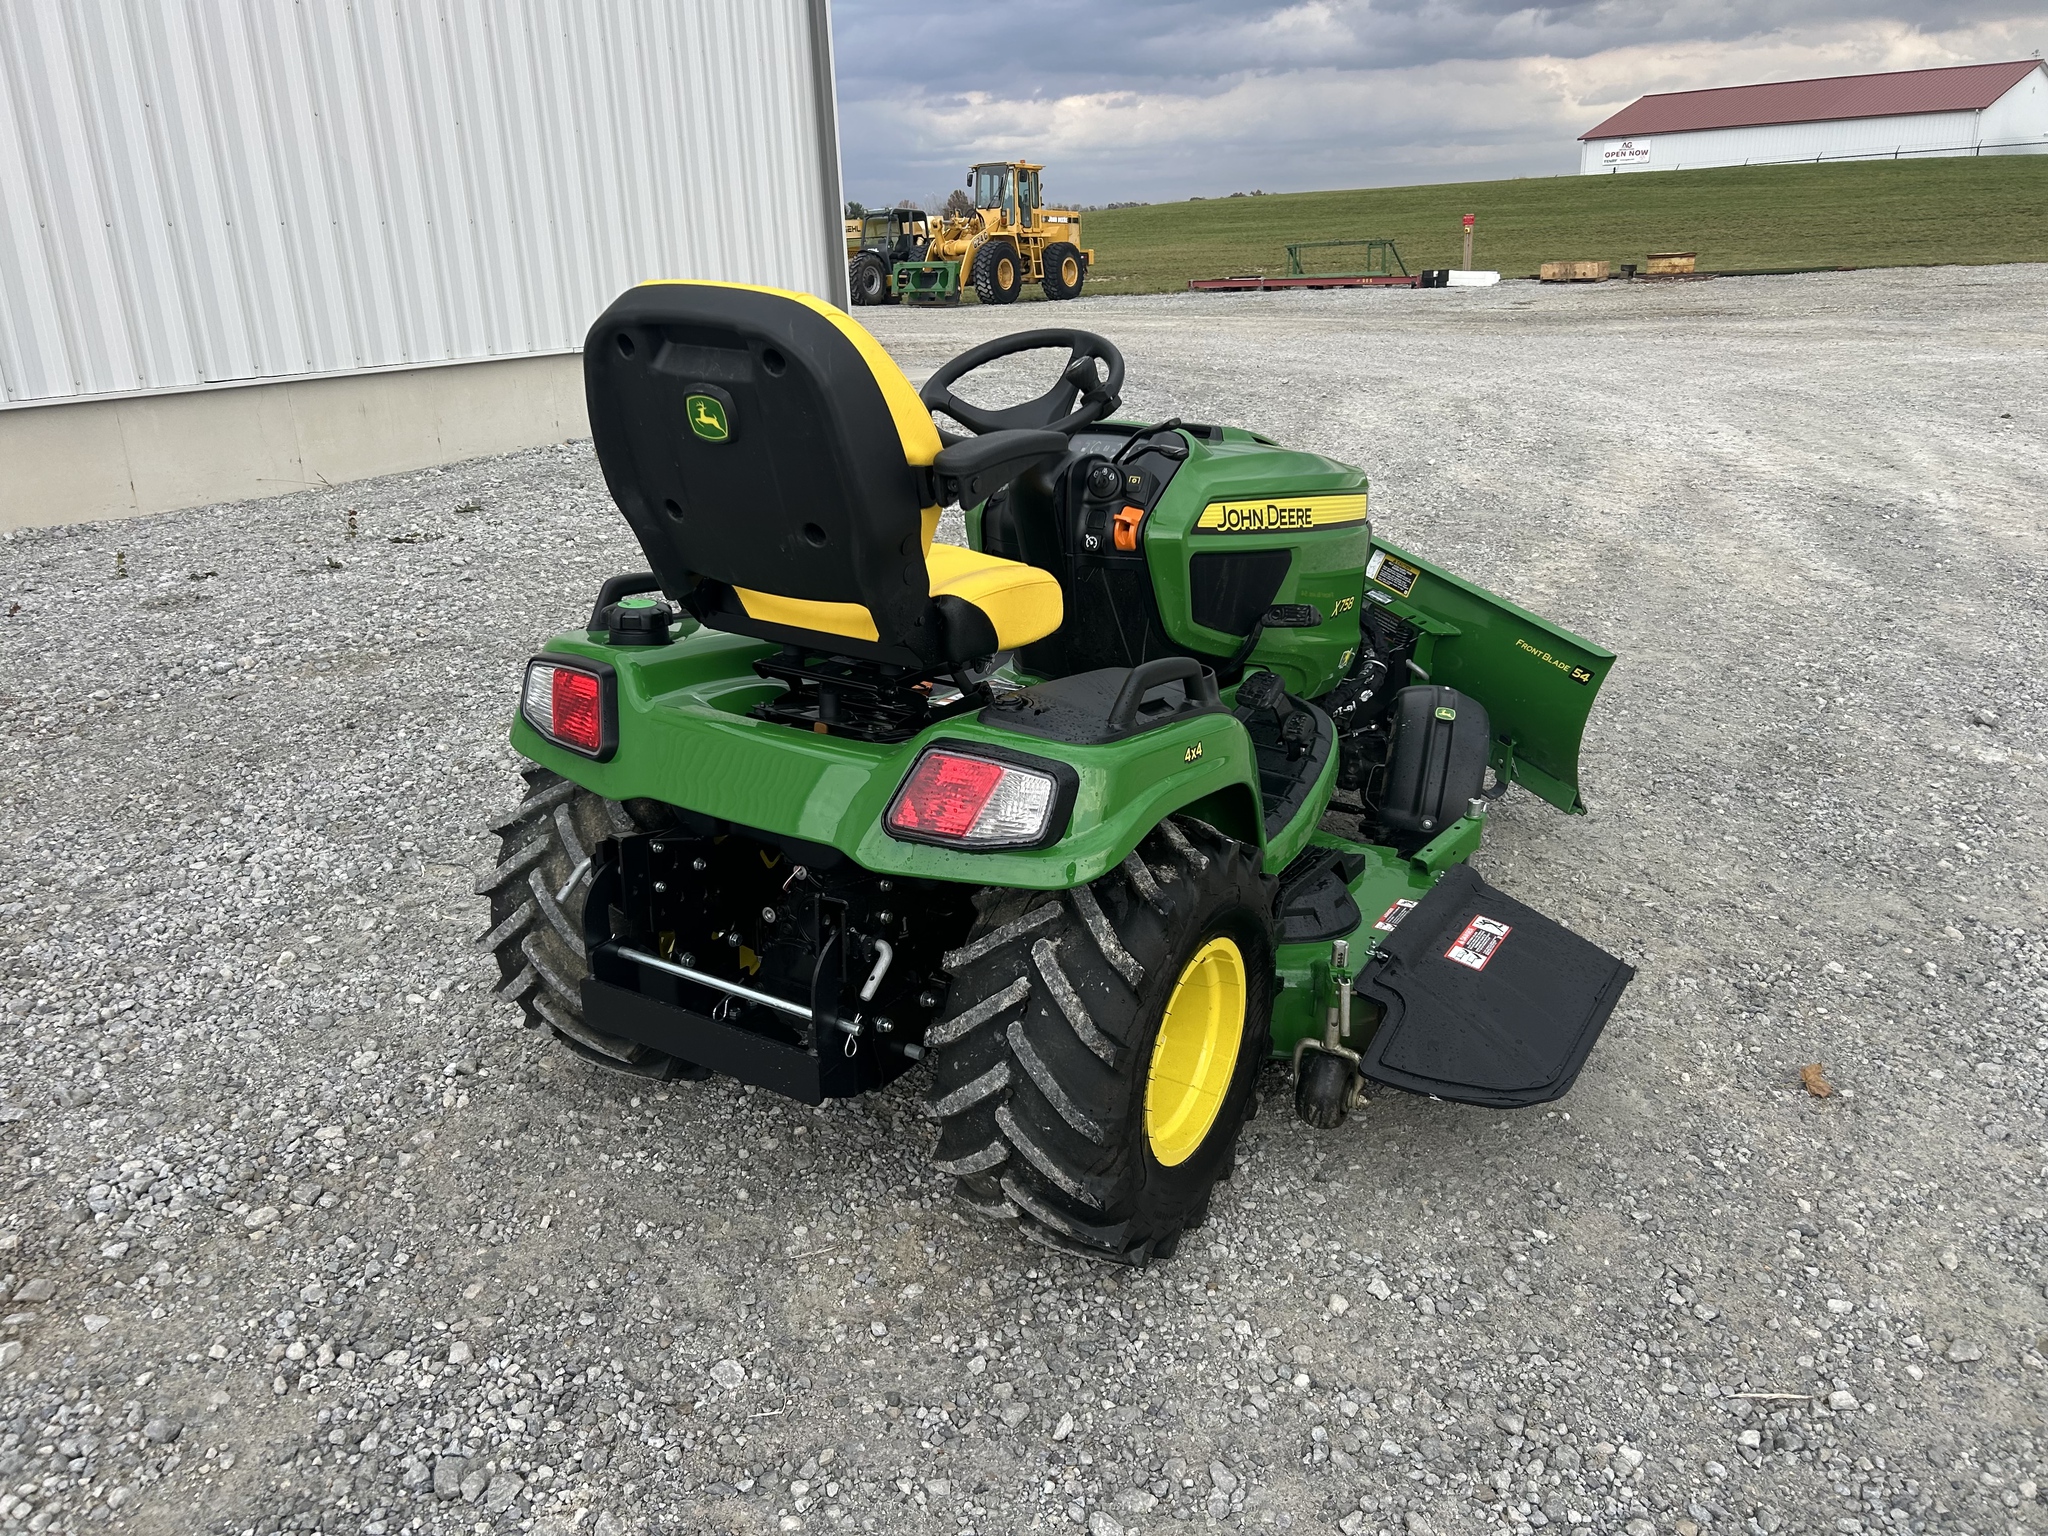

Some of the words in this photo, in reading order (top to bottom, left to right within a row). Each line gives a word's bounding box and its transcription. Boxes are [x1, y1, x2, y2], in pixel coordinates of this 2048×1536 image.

[1217, 505, 1264, 530] JOHN
[1266, 504, 1313, 529] DEERE
[1330, 596, 1354, 618] X758
[1515, 638, 1544, 657] FRONT
[1541, 652, 1571, 672] BLADE
[1571, 668, 1591, 683] 54
[1184, 741, 1203, 762] 4x4
